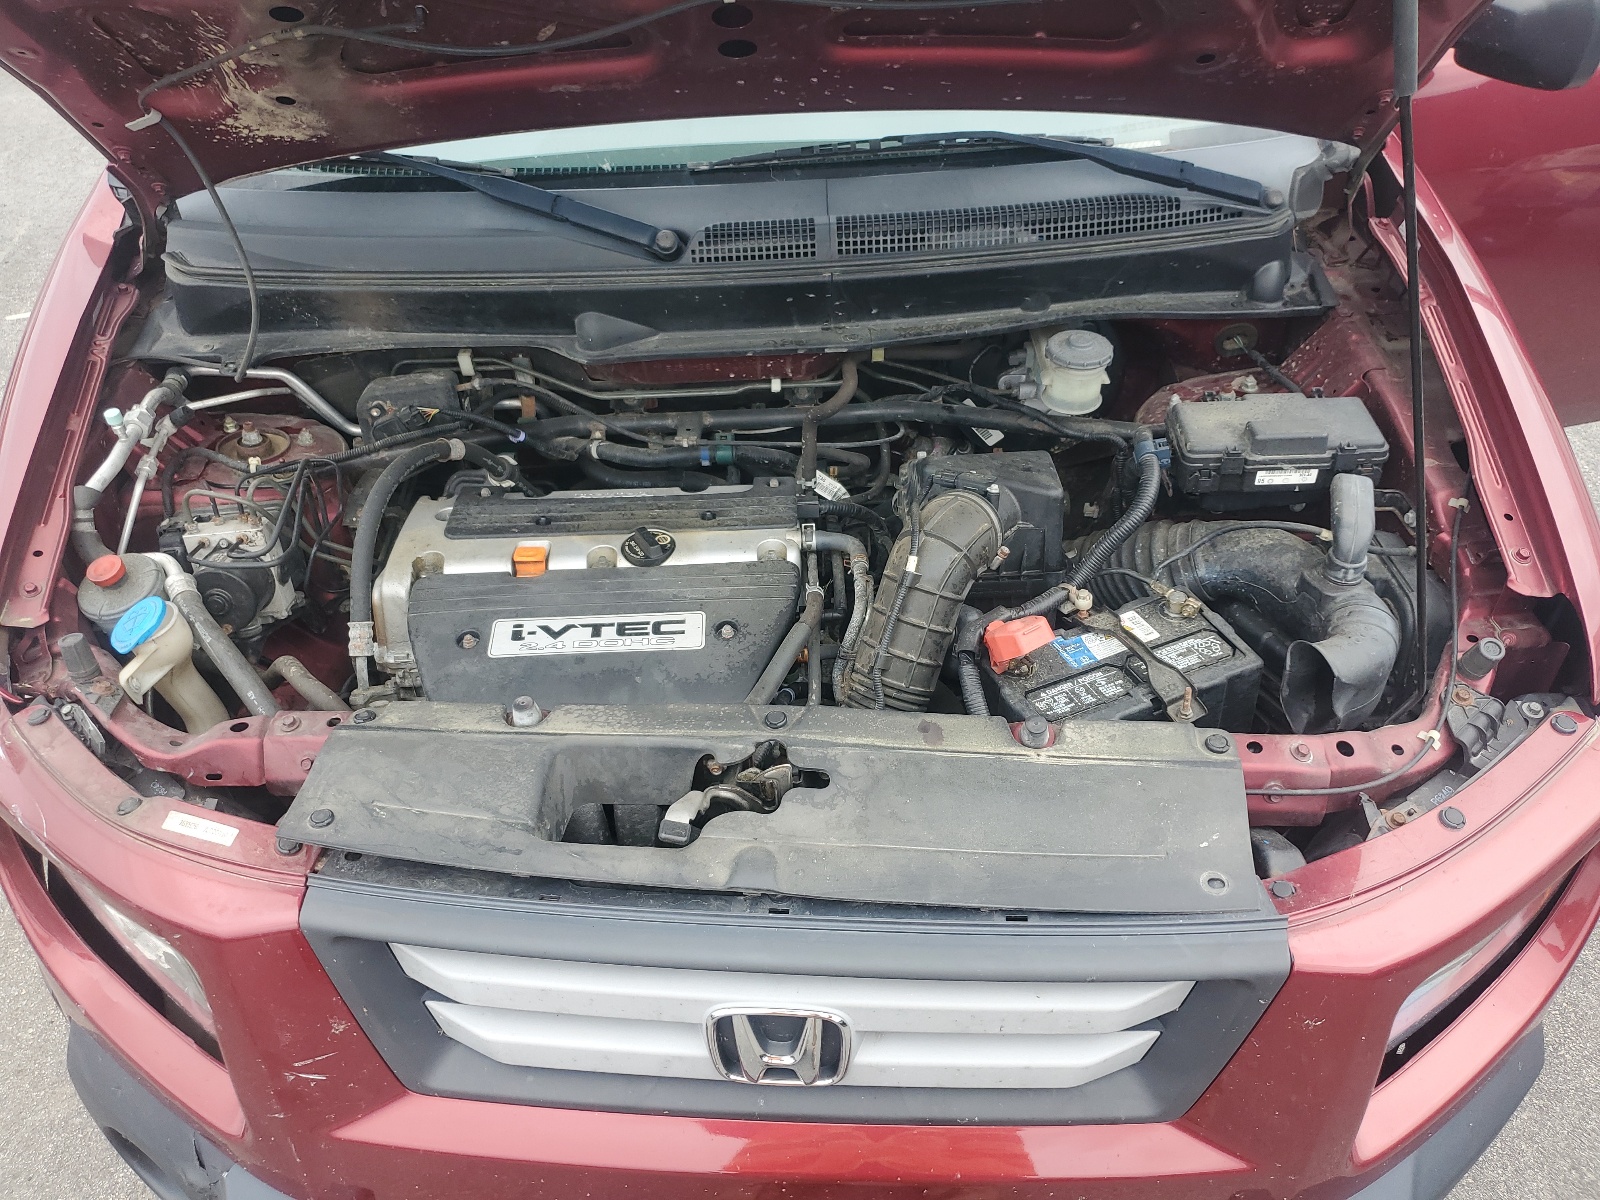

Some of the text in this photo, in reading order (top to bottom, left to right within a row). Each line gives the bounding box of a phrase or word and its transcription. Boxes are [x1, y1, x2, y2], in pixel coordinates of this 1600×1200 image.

[511, 619, 686, 641] i-VTEC
[519, 637, 675, 650] 2.4 DOHC
